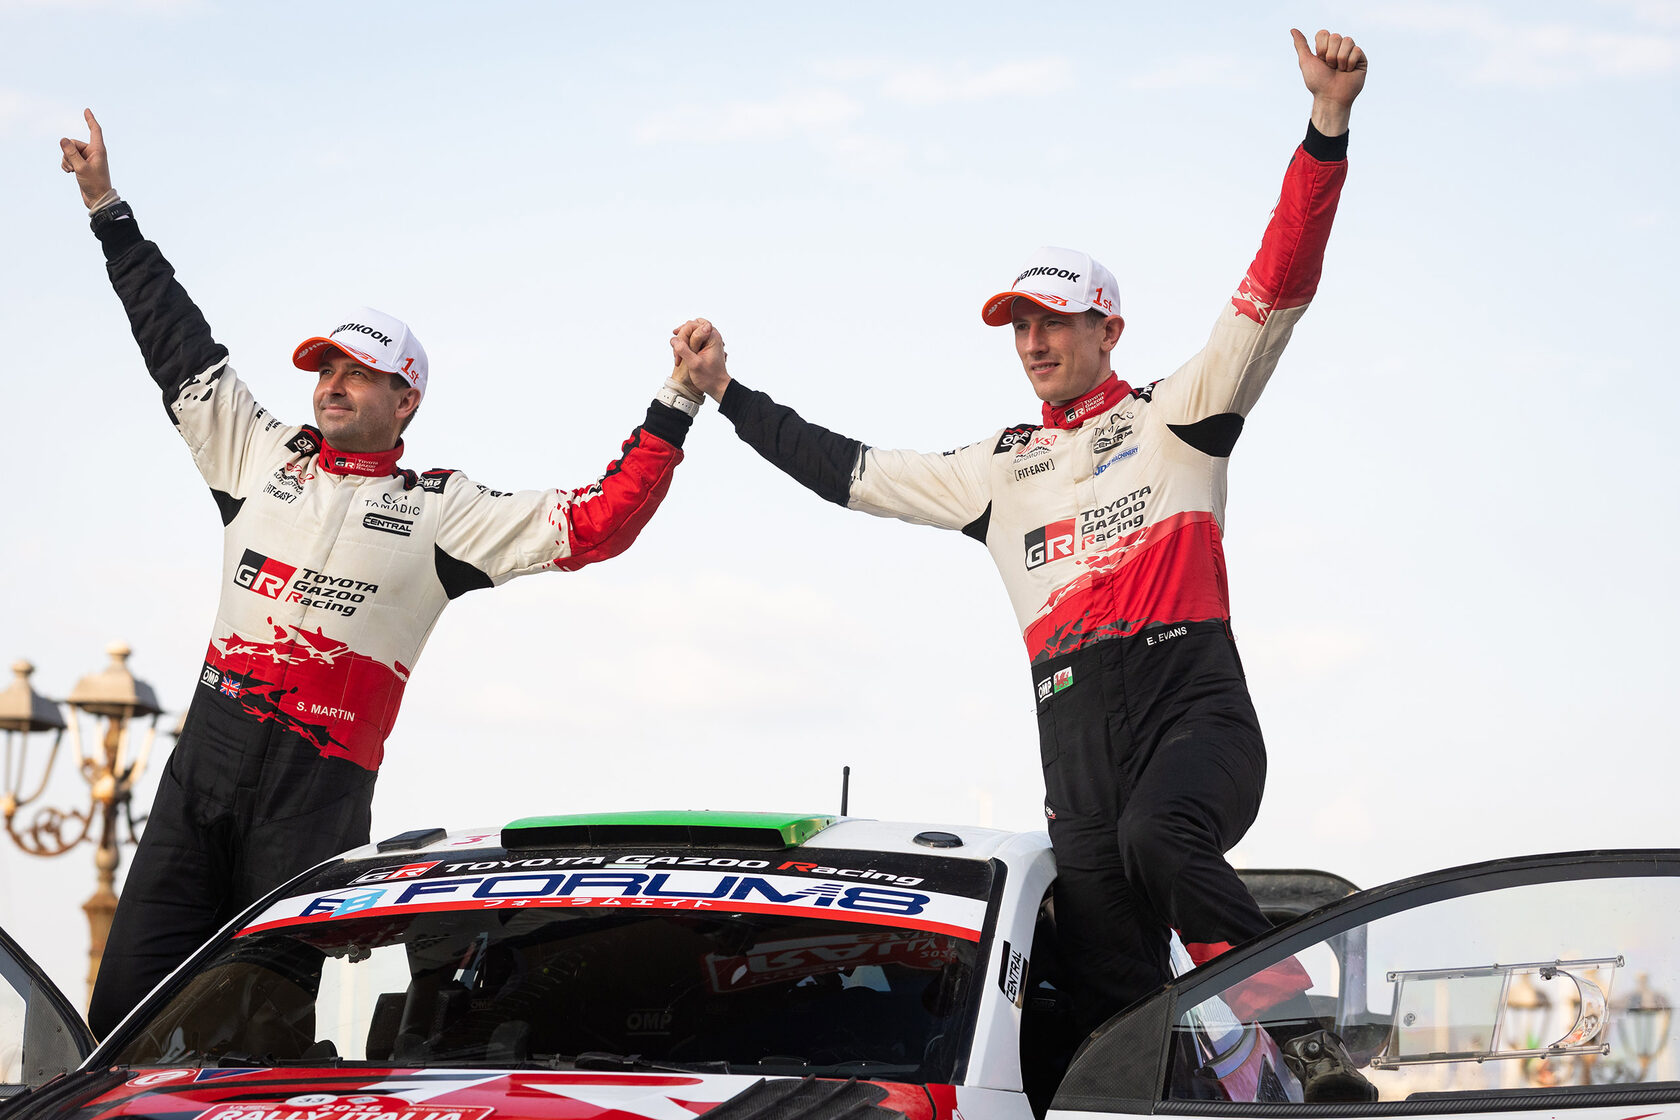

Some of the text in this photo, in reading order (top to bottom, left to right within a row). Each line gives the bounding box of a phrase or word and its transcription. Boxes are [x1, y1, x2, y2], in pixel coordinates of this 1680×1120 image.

[1093, 287, 1113, 313] 1st
[401, 357, 420, 384] 1st
[1066, 408, 1086, 422] GR
[335, 461, 355, 469] GR
[365, 499, 421, 516] TAMADIC
[1081, 485, 1151, 522] TOYOTA
[363, 517, 412, 533] CENTRAL
[1082, 500, 1146, 537] GAZOO
[1081, 513, 1144, 550] Racing
[1026, 533, 1076, 569] GR
[235, 563, 286, 599] GR
[292, 579, 366, 604] GAZOO
[300, 567, 379, 594] TOYOTA
[285, 590, 357, 617] Racing
[1146, 626, 1188, 646] E. EVANS
[202, 668, 220, 685] OMP
[1038, 680, 1052, 698] OMP
[296, 701, 355, 722] S. MARTIN
[446, 855, 925, 887] TOYOTA GAZOO Racing
[394, 873, 931, 916] FORUM8
[483, 897, 713, 908] フォーラムエイト
[1005, 949, 1022, 1004] CENTRAL
[626, 1012, 673, 1031] OMP
[317, 1104, 384, 1112] 2026
